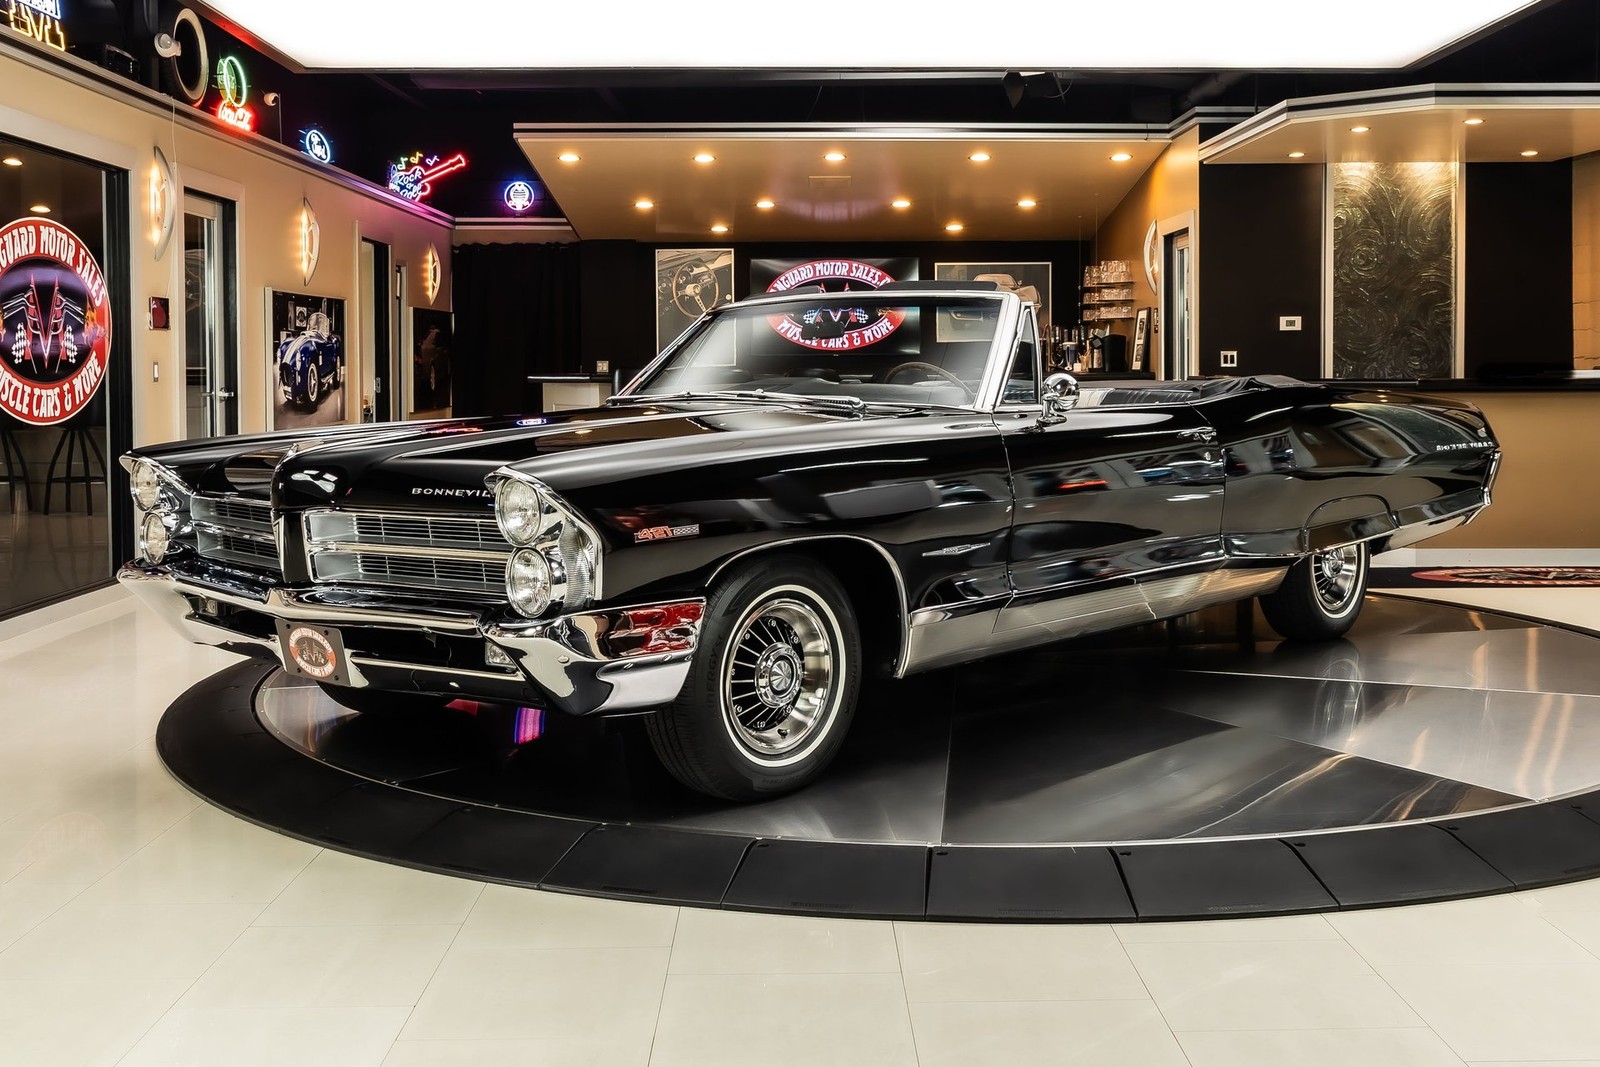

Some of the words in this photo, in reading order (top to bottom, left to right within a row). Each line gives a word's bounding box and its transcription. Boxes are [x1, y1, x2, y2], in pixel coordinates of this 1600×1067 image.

[396, 168, 422, 186] Rock
[0, 225, 36, 268] GUARD
[39, 225, 76, 264] MOTOR
[77, 249, 106, 307] SALES
[770, 265, 814, 292] NGUARD
[814, 262, 849, 277] MOTOR
[821, 334, 849, 348] CARS
[853, 332, 861, 346] &
[863, 318, 894, 344] MORE
[33, 387, 60, 417] CARS
[63, 383, 73, 411] &
[73, 350, 102, 406] MORE
[411, 487, 495, 498] BONNEVIL
[638, 526, 673, 540] 421
